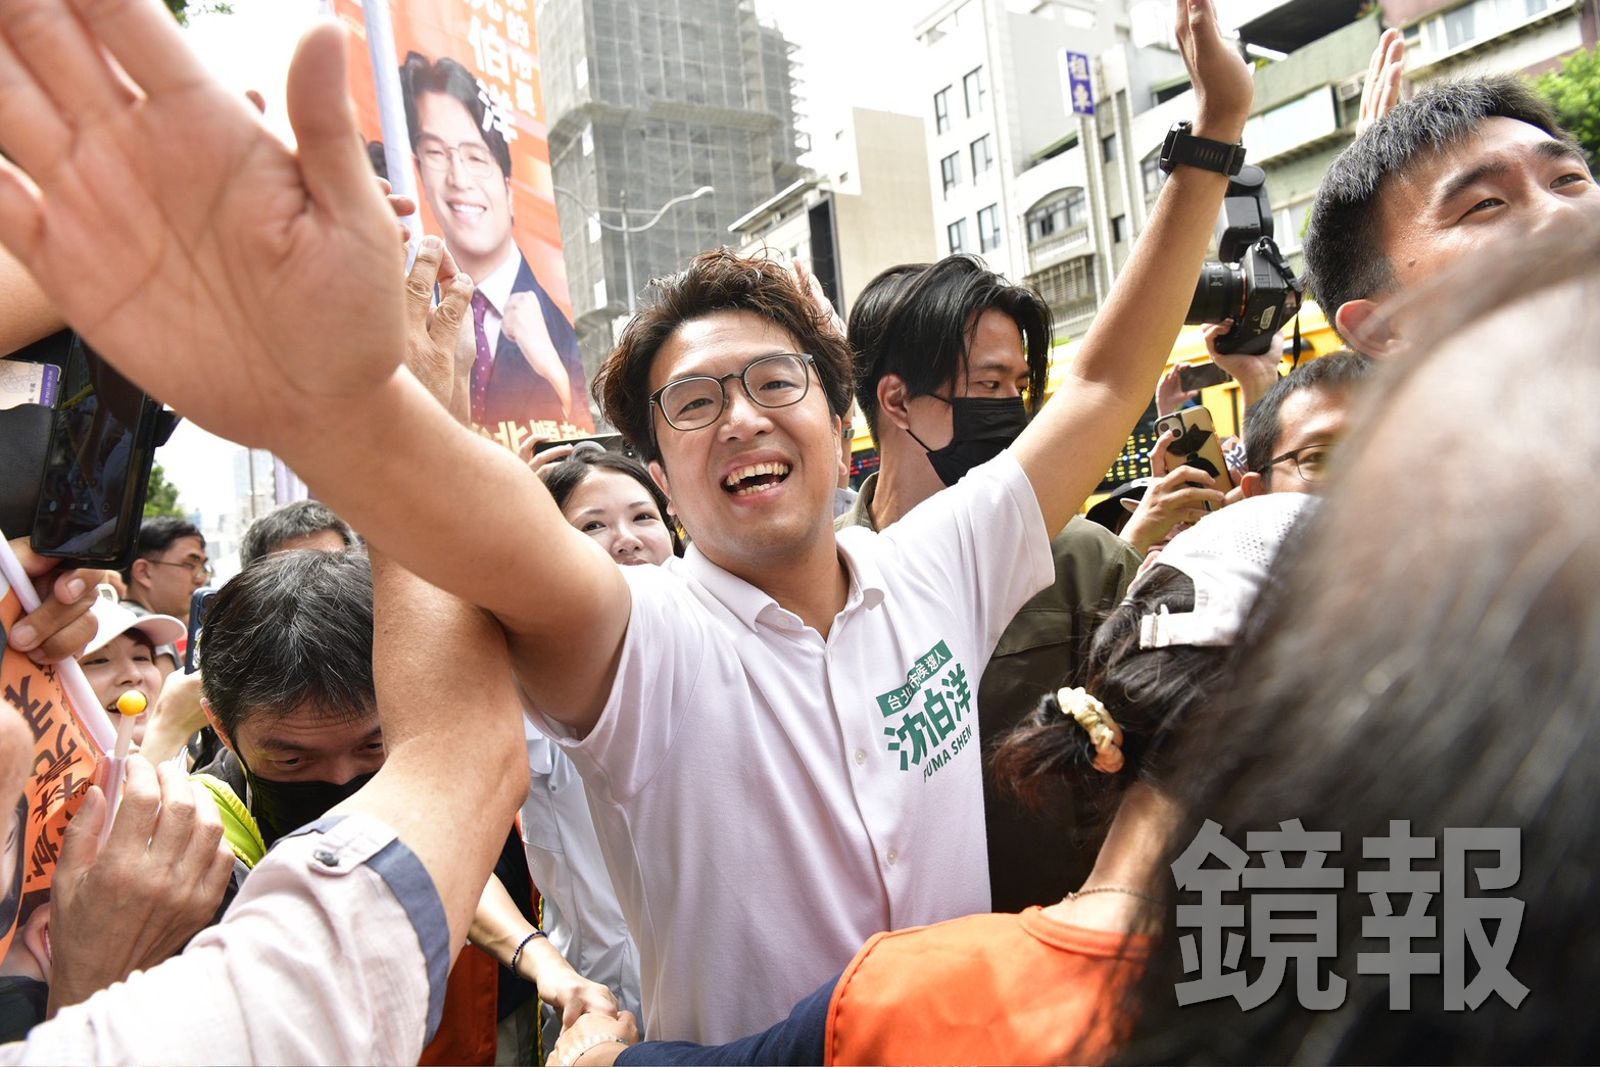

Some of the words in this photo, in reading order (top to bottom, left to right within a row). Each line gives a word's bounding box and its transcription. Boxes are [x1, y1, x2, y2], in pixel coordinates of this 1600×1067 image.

[883, 663, 972, 771] 沈伯洋
[923, 748, 952, 784] FUMA
[953, 723, 973, 756] SHEN
